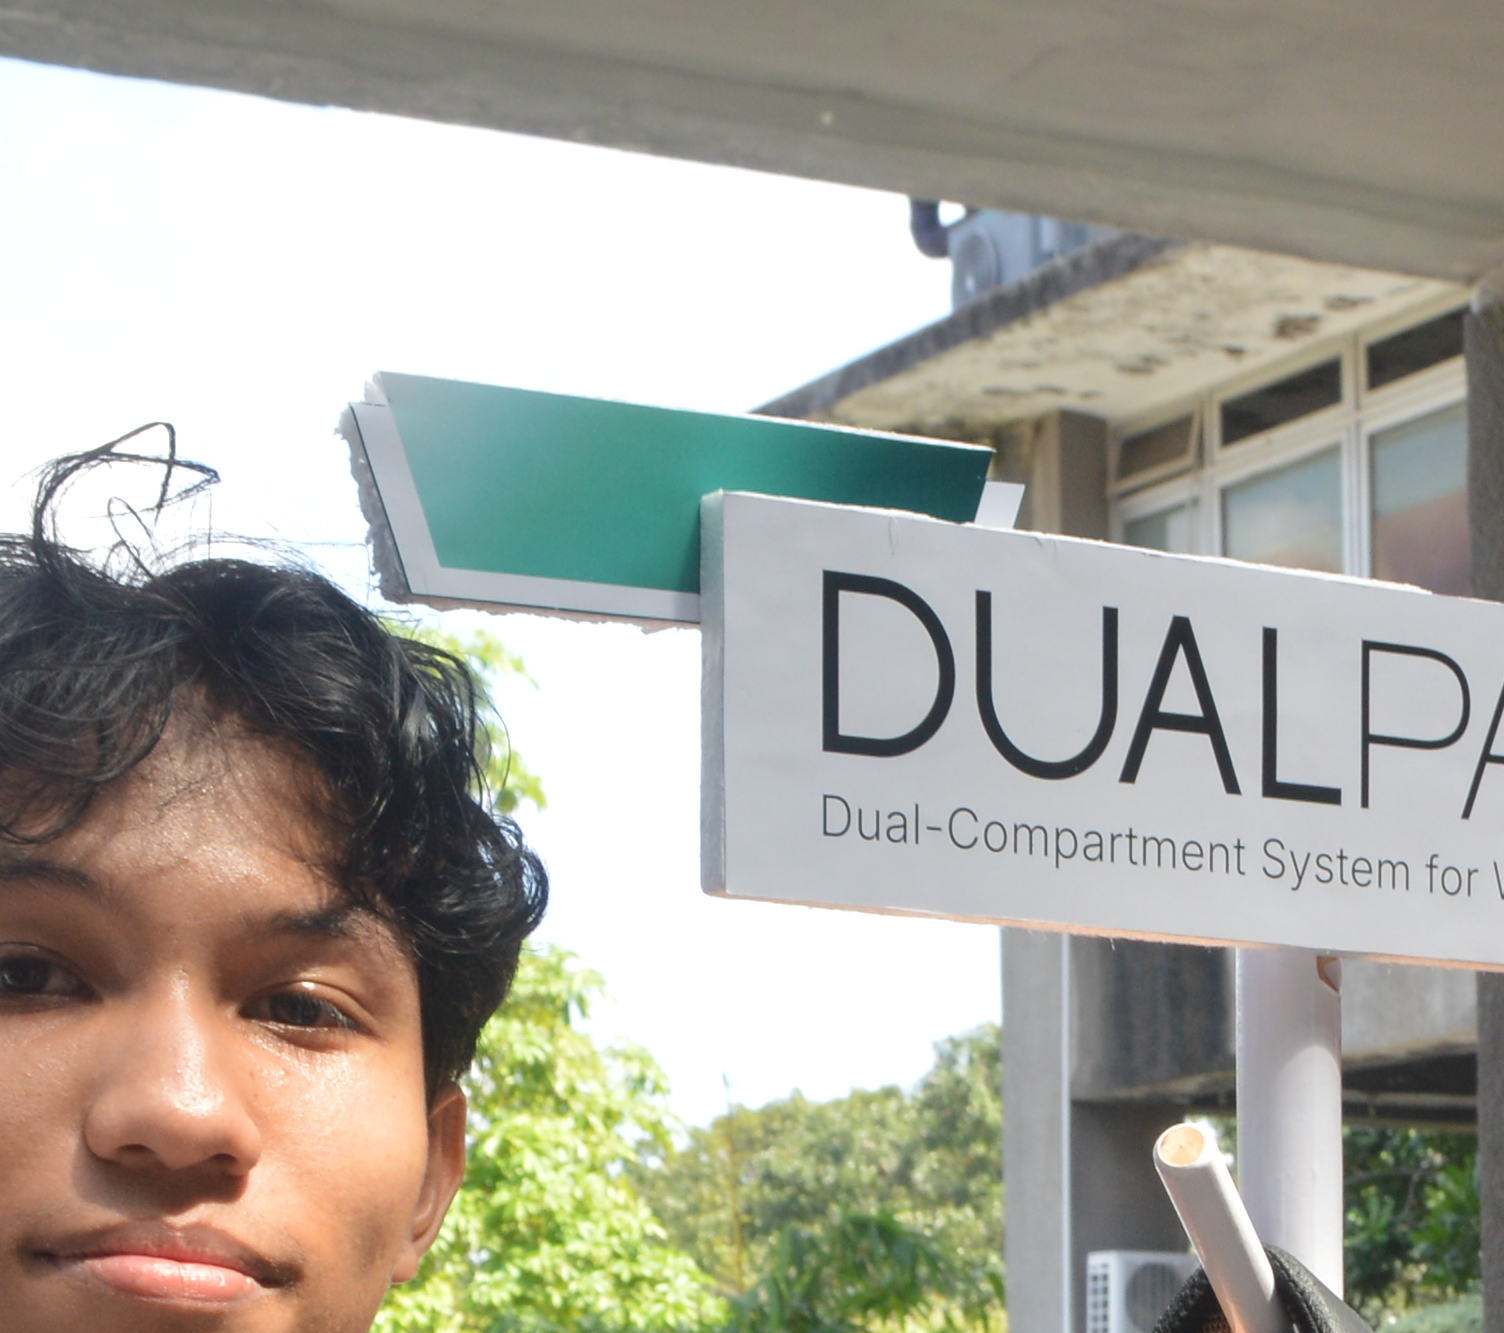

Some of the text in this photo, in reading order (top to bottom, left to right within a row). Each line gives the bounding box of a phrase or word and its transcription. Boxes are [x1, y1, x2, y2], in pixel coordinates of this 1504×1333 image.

[821, 793, 1248, 878] Dual-Compartment
[1261, 838, 1411, 896] System
[1424, 850, 1480, 898] for
